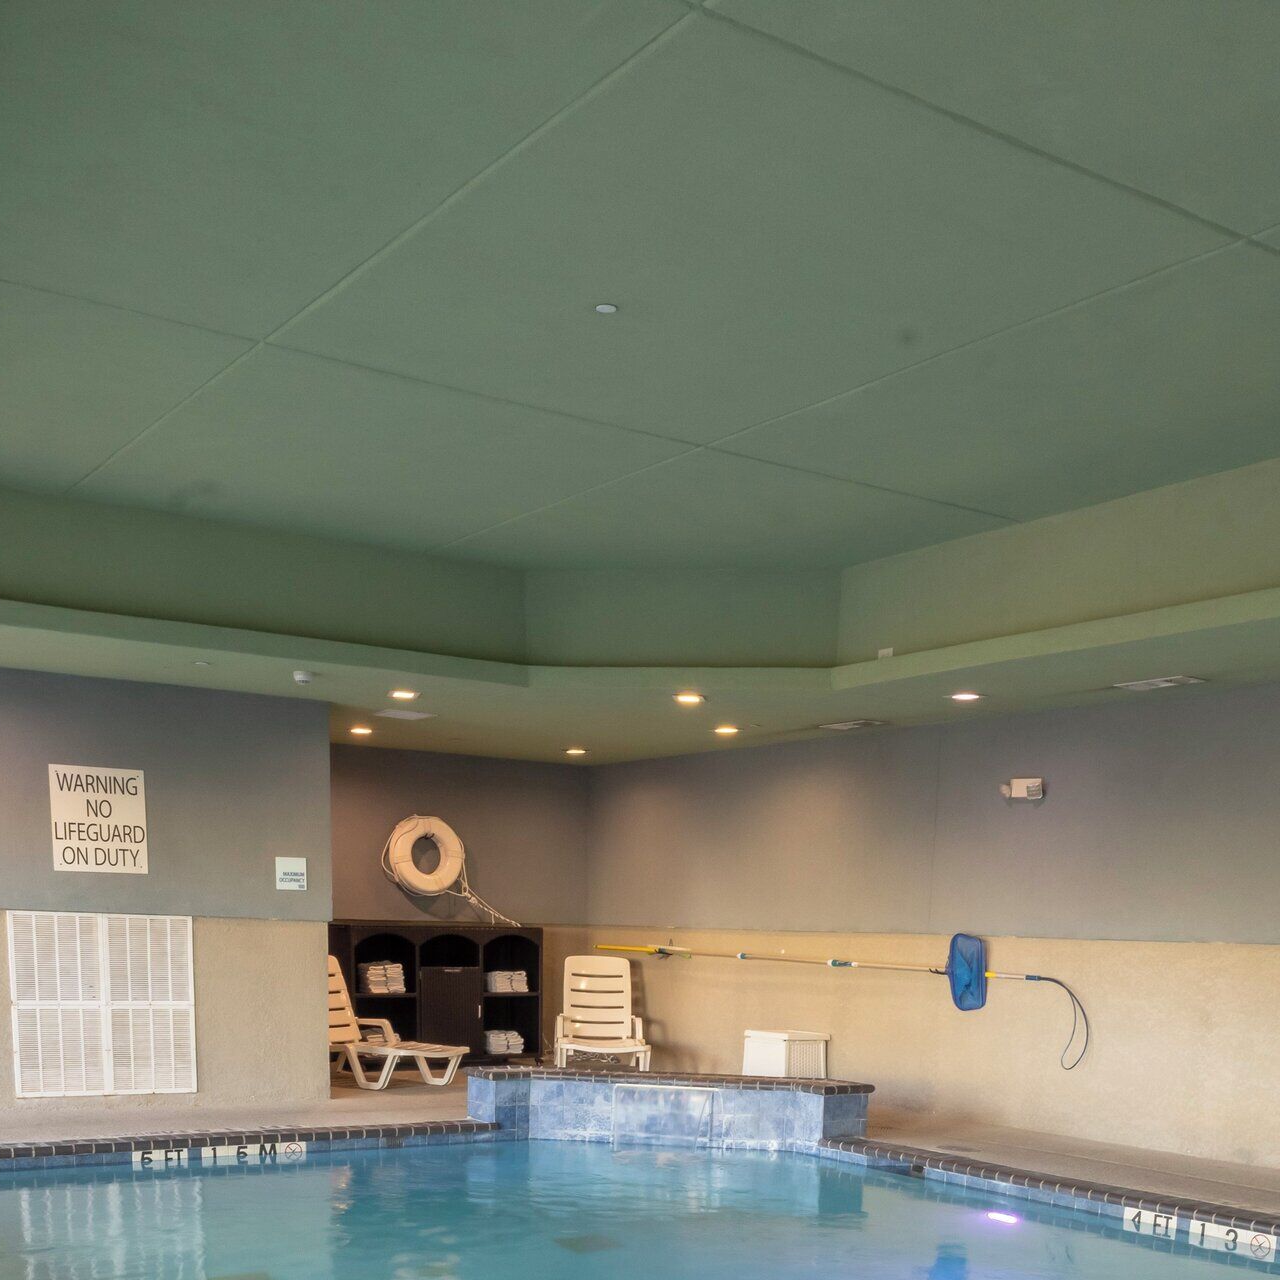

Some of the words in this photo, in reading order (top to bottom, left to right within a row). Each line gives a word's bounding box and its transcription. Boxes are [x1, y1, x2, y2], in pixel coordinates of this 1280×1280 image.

[56, 772, 138, 796] WARNING
[86, 799, 112, 818] NO
[54, 821, 145, 843] LIFEGUARD
[62, 846, 88, 865] ON
[94, 847, 140, 867] DUTY
